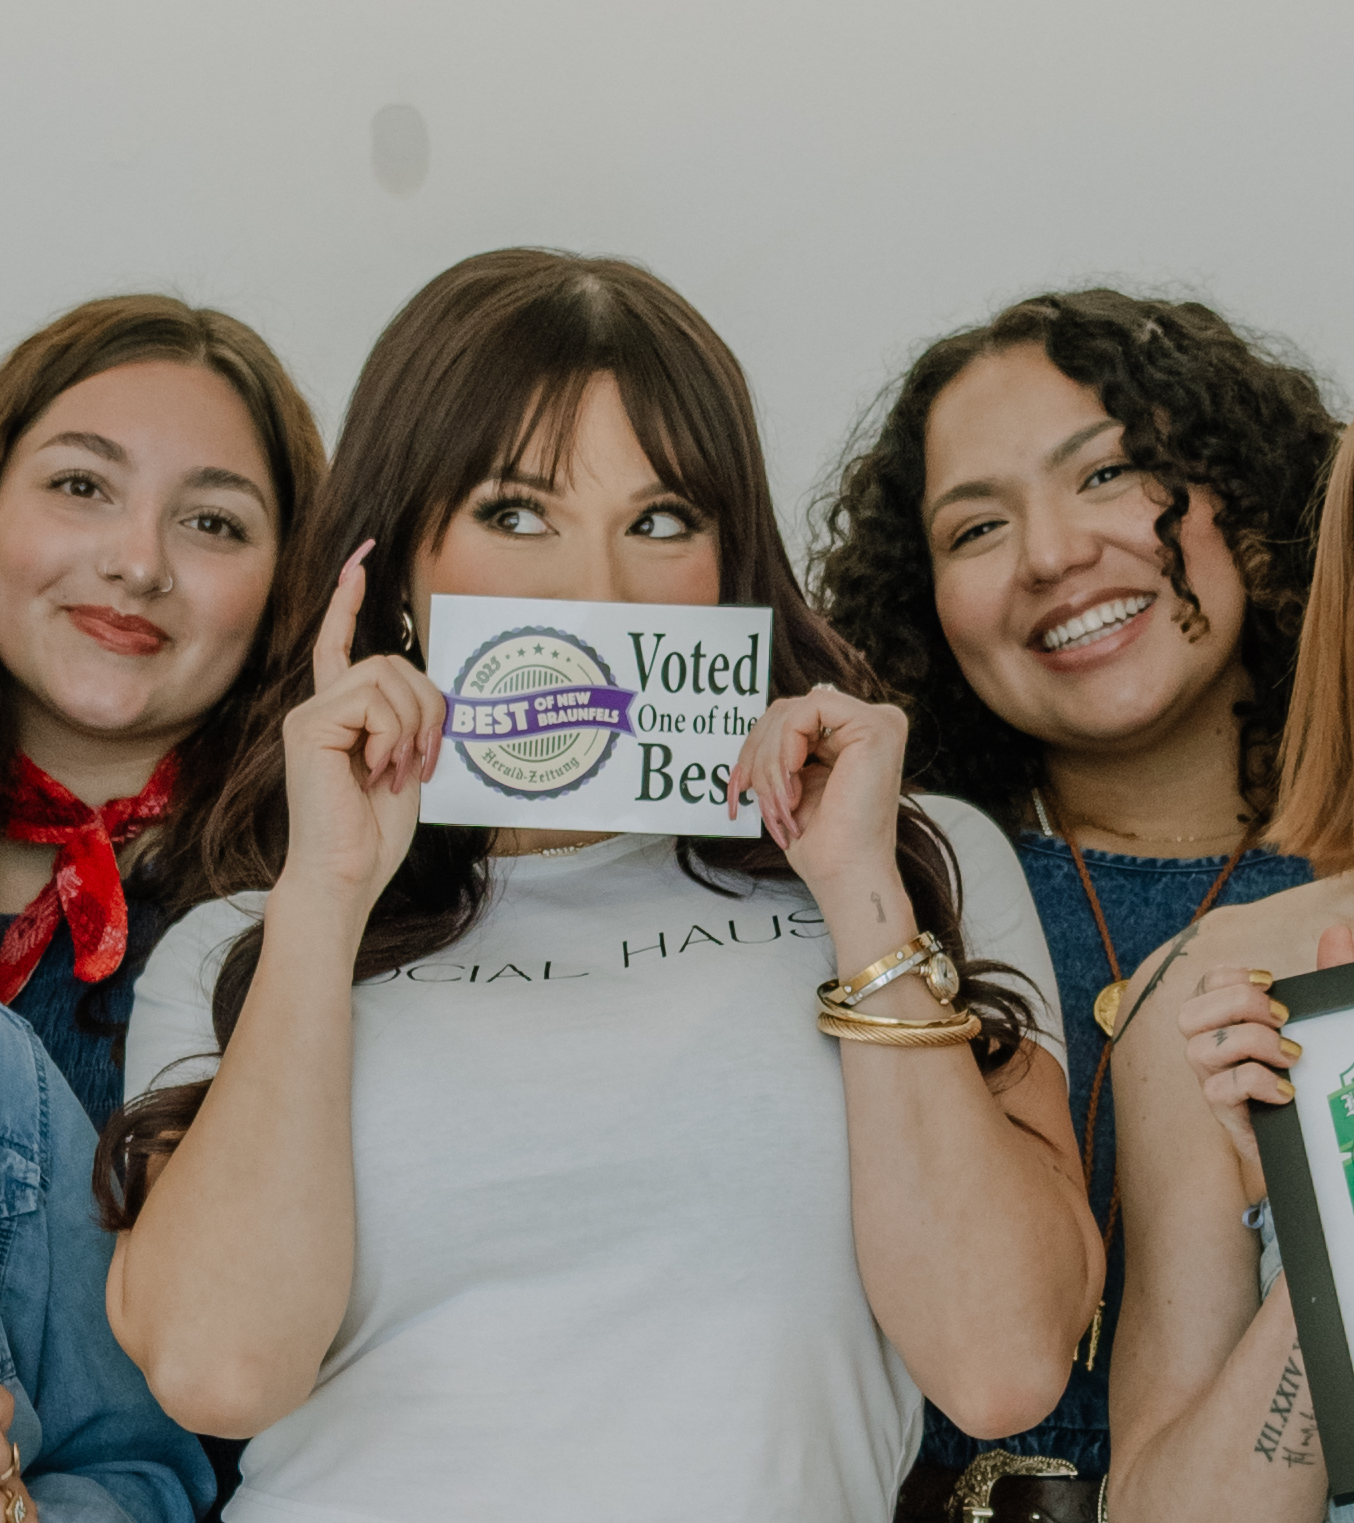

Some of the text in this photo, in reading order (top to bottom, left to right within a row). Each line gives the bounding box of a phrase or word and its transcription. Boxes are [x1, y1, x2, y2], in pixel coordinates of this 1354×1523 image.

[469, 654, 502, 693] 2025
[627, 632, 760, 696] Voted
[451, 700, 530, 735] BEST
[534, 690, 591, 712] OF NEW
[536, 707, 620, 728] BRAUNFELS
[638, 703, 686, 734] One
[692, 705, 719, 735] of
[480, 747, 581, 785] Herald-Zeitung
[622, 907, 830, 969] HAUS
